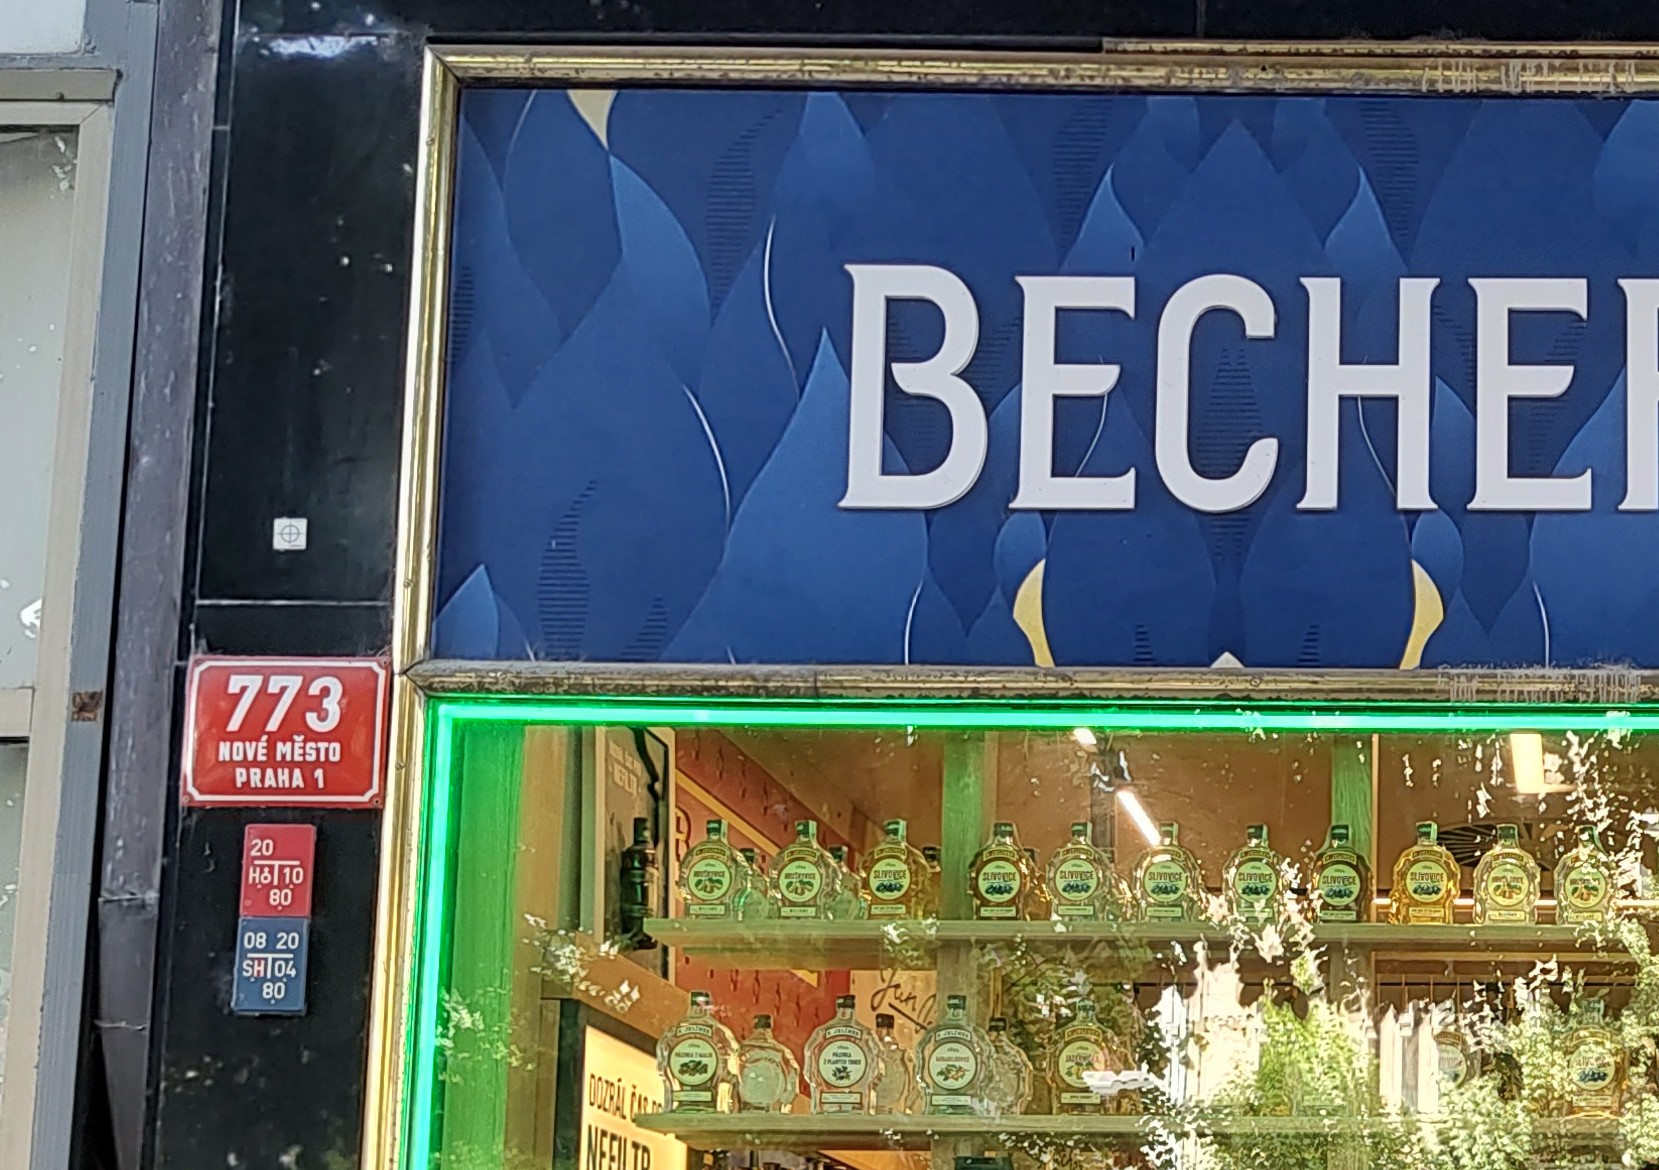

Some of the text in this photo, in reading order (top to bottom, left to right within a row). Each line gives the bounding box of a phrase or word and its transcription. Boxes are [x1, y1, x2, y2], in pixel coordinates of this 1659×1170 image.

[226, 675, 344, 733] 773
[218, 736, 341, 763] NOVÉ MĚSTO
[235, 768, 324, 789] PRAHA 1
[251, 840, 273, 856] 20
[283, 866, 303, 884] 10
[269, 889, 292, 906] 80
[244, 932, 299, 949] 08 20
[275, 960, 297, 978] 04
[262, 982, 285, 1000] 80
[590, 1074, 626, 1119] DOZRÁL
